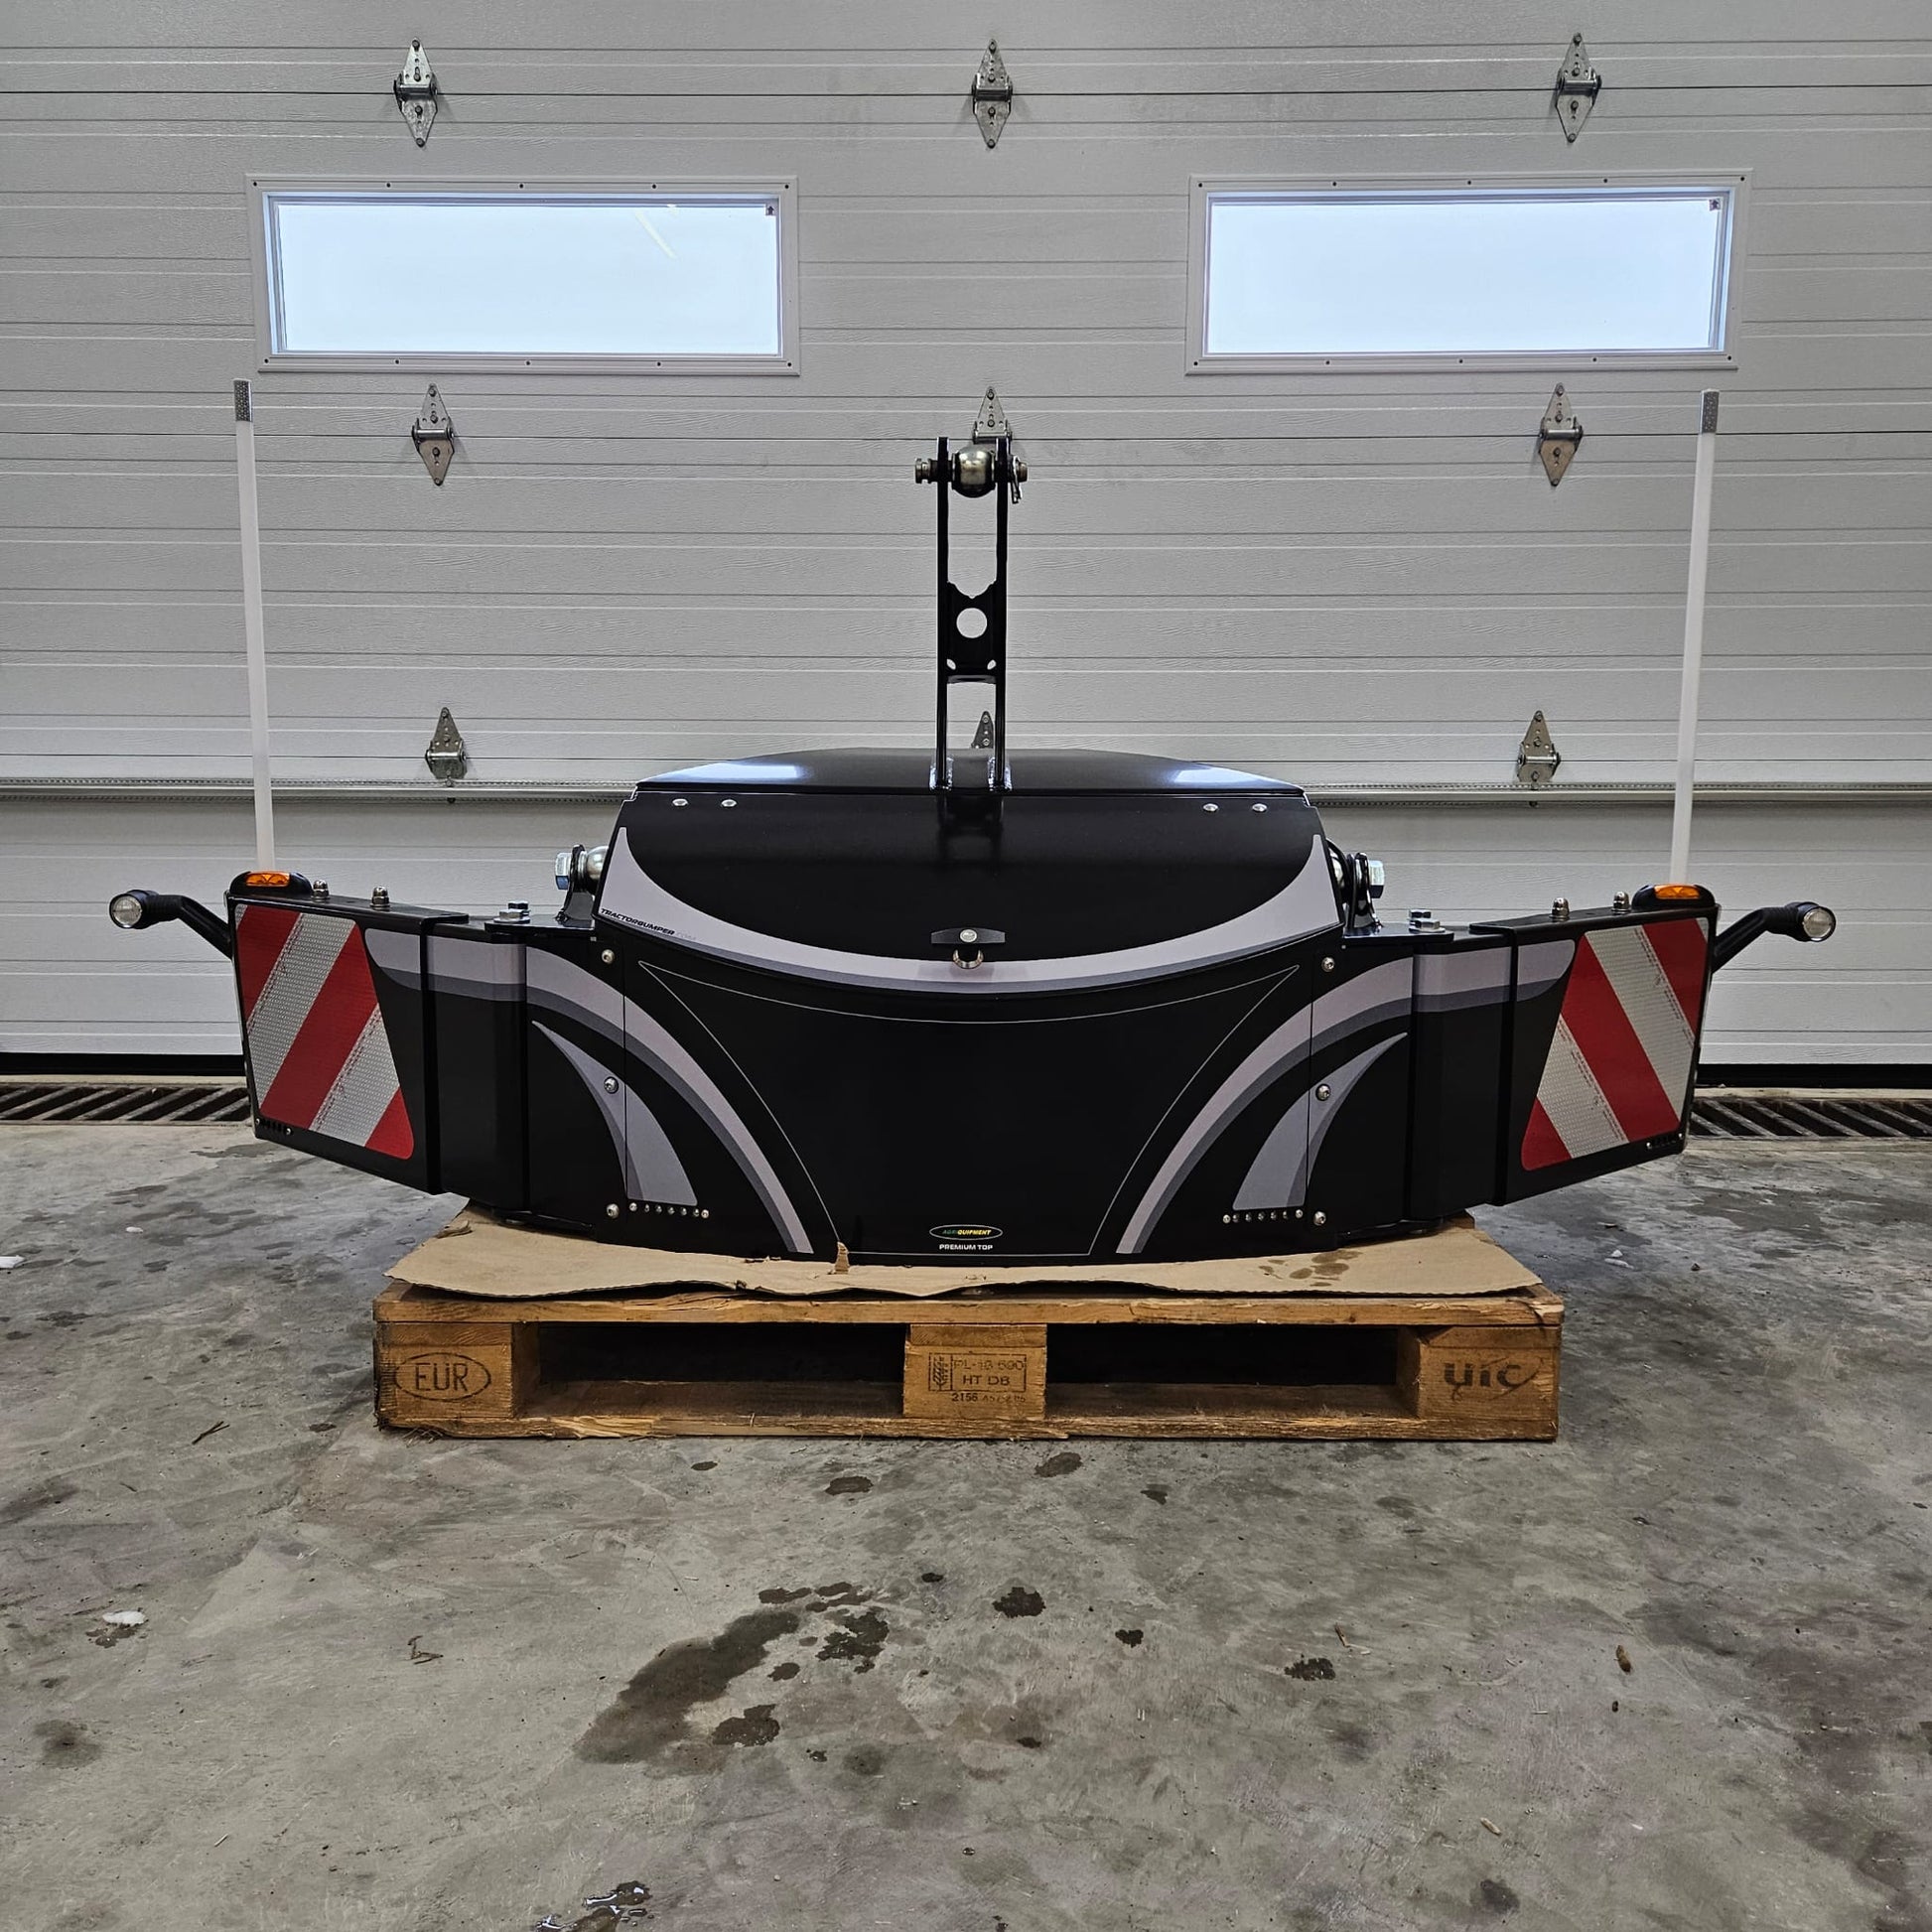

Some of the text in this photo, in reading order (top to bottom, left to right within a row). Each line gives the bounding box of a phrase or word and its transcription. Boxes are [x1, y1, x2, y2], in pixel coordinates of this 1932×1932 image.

[601, 908, 675, 935] TRACTORBUMPER
[415, 1362, 468, 1392] EUR
[962, 1375, 1011, 1386] HT DB
